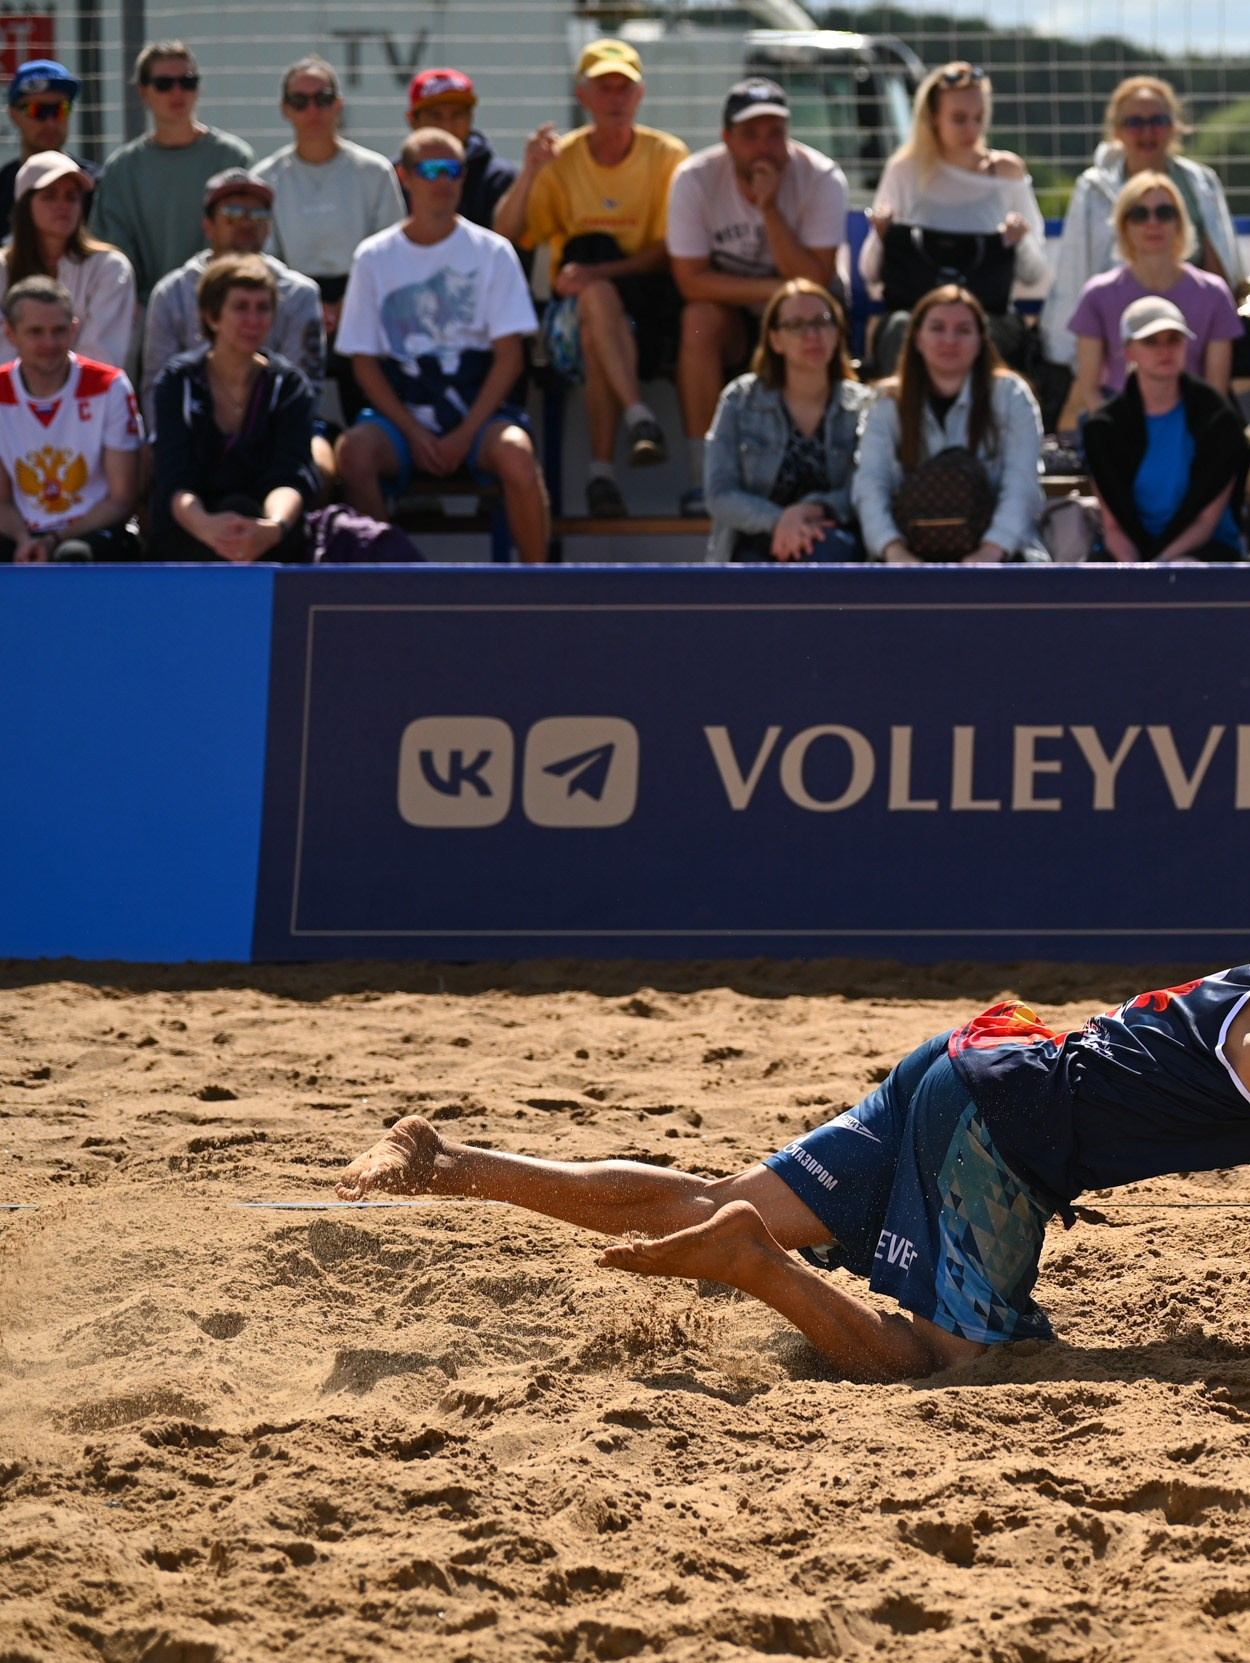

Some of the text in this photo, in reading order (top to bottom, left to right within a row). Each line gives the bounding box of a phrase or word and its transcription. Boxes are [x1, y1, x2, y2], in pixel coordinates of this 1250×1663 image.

[331, 27, 430, 87] TV
[418, 749, 494, 798] VK
[791, 1145, 838, 1191] ГАЗПРОМ
